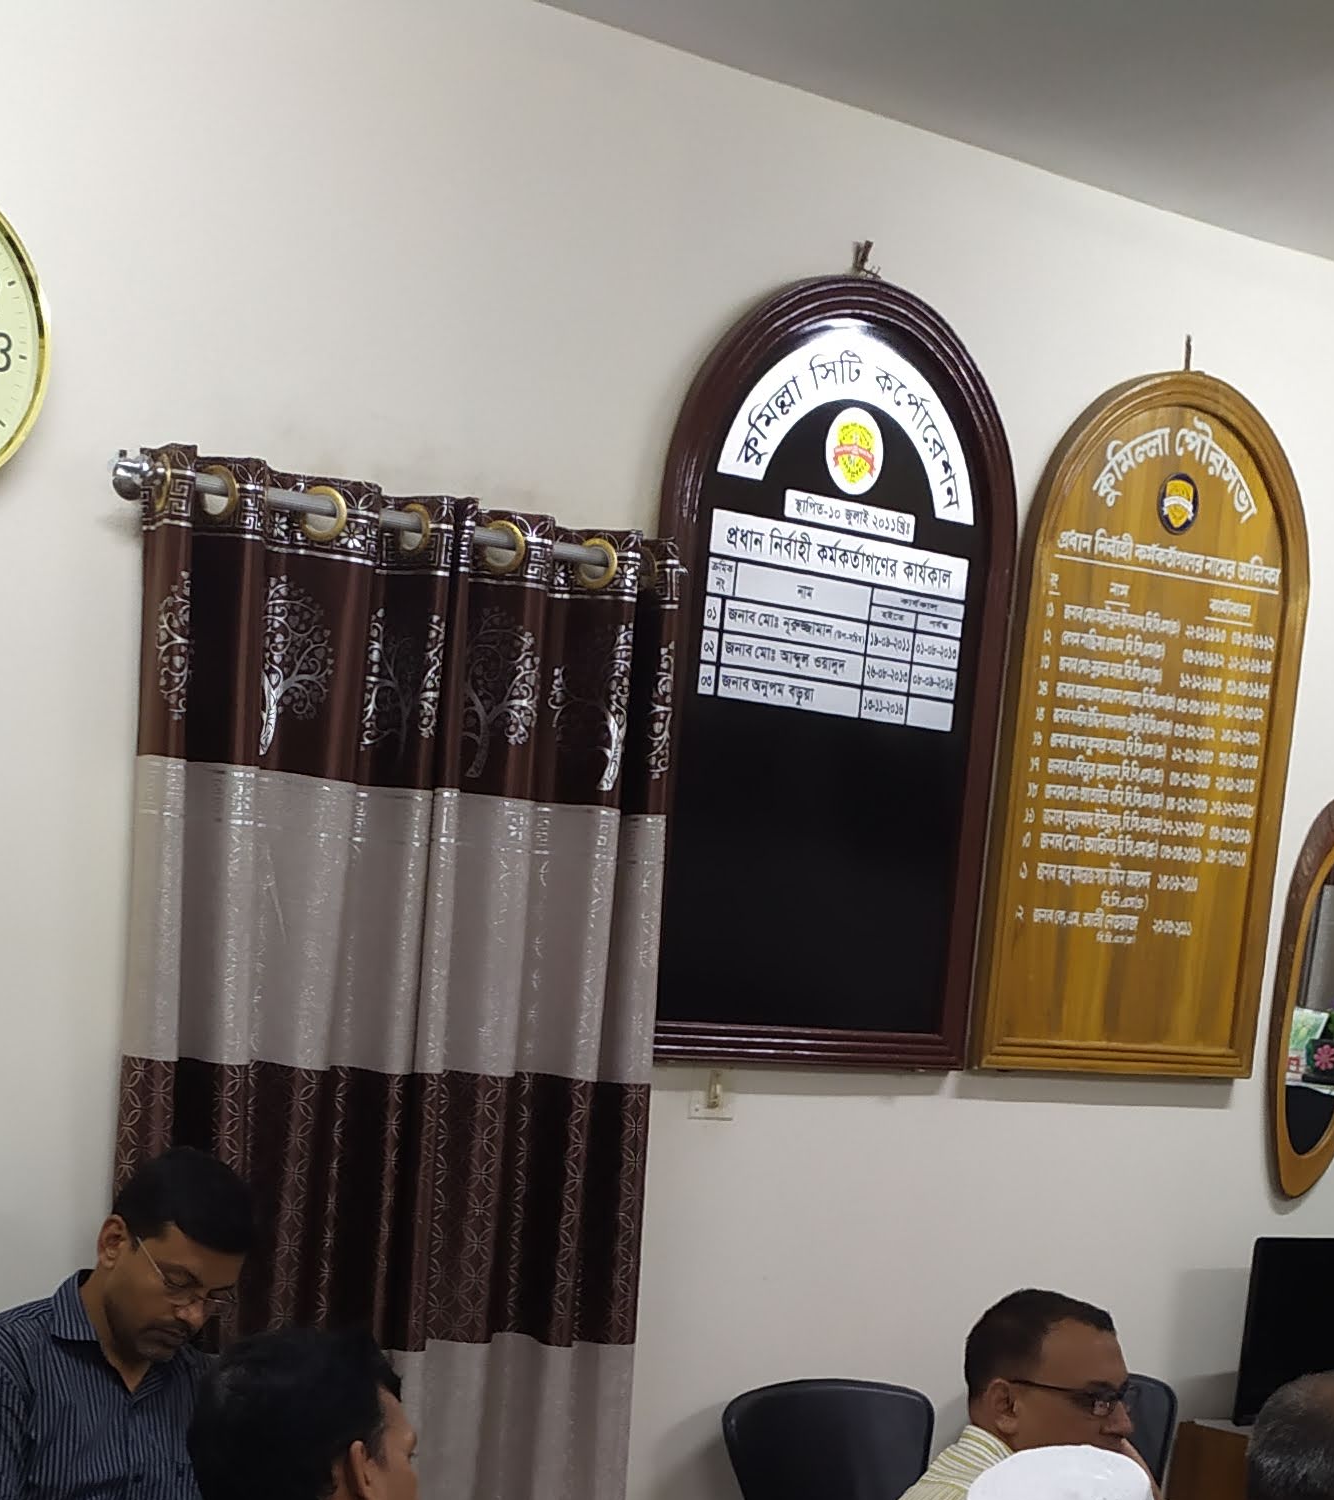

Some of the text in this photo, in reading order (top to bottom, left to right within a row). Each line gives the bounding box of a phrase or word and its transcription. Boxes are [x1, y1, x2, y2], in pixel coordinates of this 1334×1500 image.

[736, 375, 803, 466] কুমিল্লা
[809, 350, 862, 390] সিটি
[875, 366, 959, 509] কর্পোরেশন
[1175, 416, 1258, 524] পৌরসভা
[844, 507, 869, 527] জুলাই
[725, 523, 952, 589] প্রধান নির্বাহী কর্মকর্তাগণের কার্যকাল
[706, 605, 717, 620] ০১
[727, 607, 755, 624] জনাব
[703, 640, 715, 655] ০২
[724, 640, 752, 658] জনাব
[700, 674, 712, 686] ০৩
[721, 674, 749, 691] জনাব
